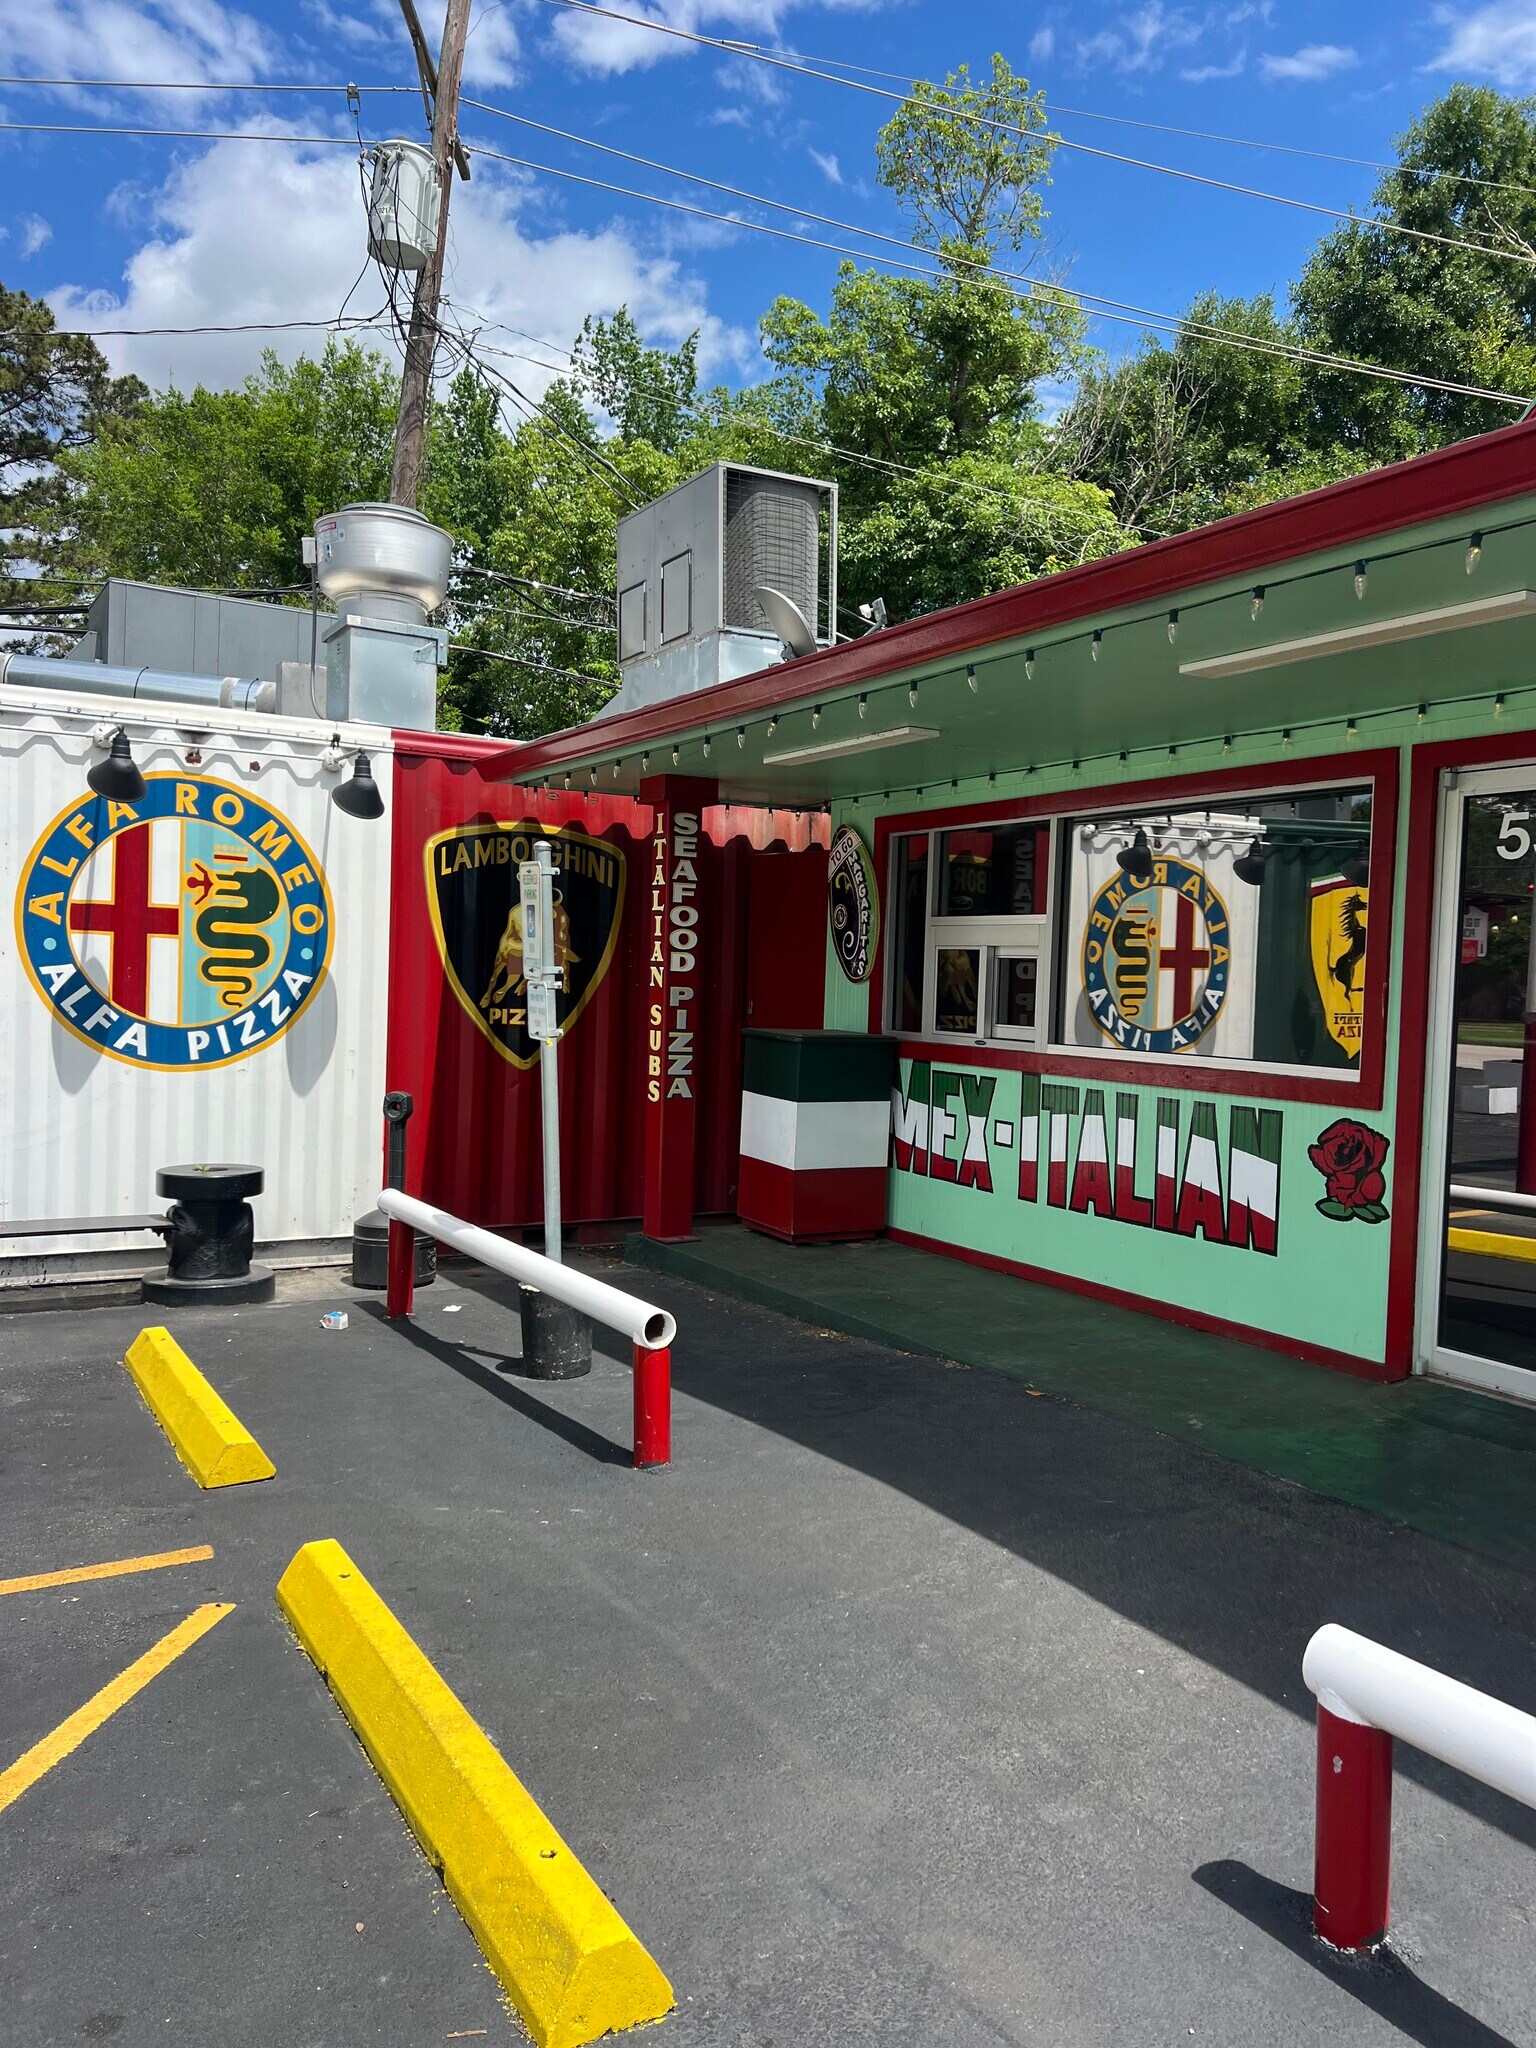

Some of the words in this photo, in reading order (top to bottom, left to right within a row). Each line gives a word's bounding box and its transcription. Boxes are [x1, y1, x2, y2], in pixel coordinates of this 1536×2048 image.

[29, 800, 139, 925] ALFA
[176, 783, 324, 934] ROMEO
[441, 836, 613, 888] LAMBOGHINI
[830, 852, 842, 866] TO
[841, 837, 853, 851] GO
[1496, 812, 1536, 860] 5
[650, 812, 667, 988] ITALIAN
[669, 812, 699, 972] SEAFOOD
[847, 850, 869, 976] MARGARITAS
[39, 963, 147, 1056] ALFA
[187, 968, 313, 1060] PIZZA
[489, 1008, 526, 1025] PIZ
[648, 1004, 662, 1102] SUBS
[667, 986, 694, 1098] PIZZA
